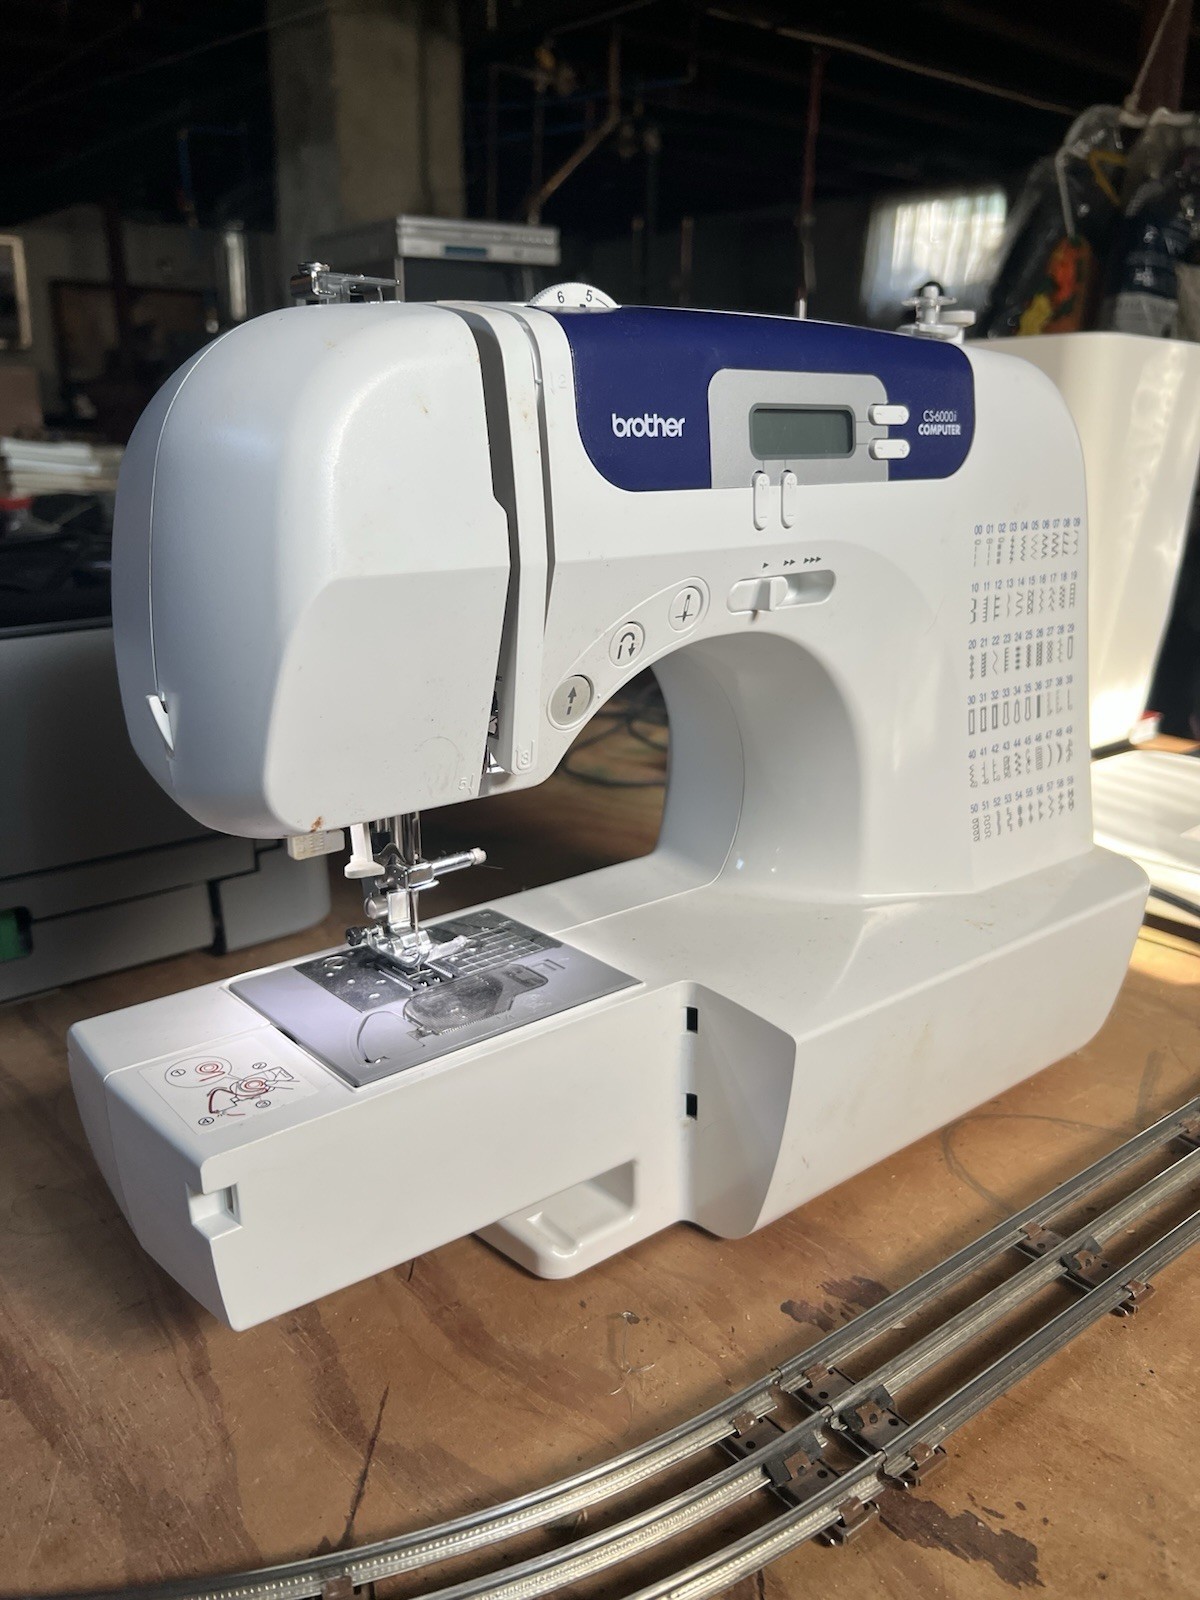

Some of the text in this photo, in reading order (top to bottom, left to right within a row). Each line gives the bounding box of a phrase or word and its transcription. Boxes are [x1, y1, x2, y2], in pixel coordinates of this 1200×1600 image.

[557, 289, 592, 303] 6 5
[611, 413, 685, 438] brother
[918, 424, 961, 436] COMPUTER
[974, 517, 1080, 535] 00 01 02 03 04 05 06 07 08 09
[972, 571, 1077, 592] 10 11 12 13 14 15 16 17 18 19
[968, 623, 1074, 649] 20 21 22 23 24 25 26 27 28 29
[968, 675, 1072, 705] 30 31 32 33 34 35 36 37 38 39
[968, 725, 1072, 759] 40 41 42 43 44 45 46 47 48 49
[971, 776, 1074, 813] 50 51 52 53 54 55 56 57 58 59
